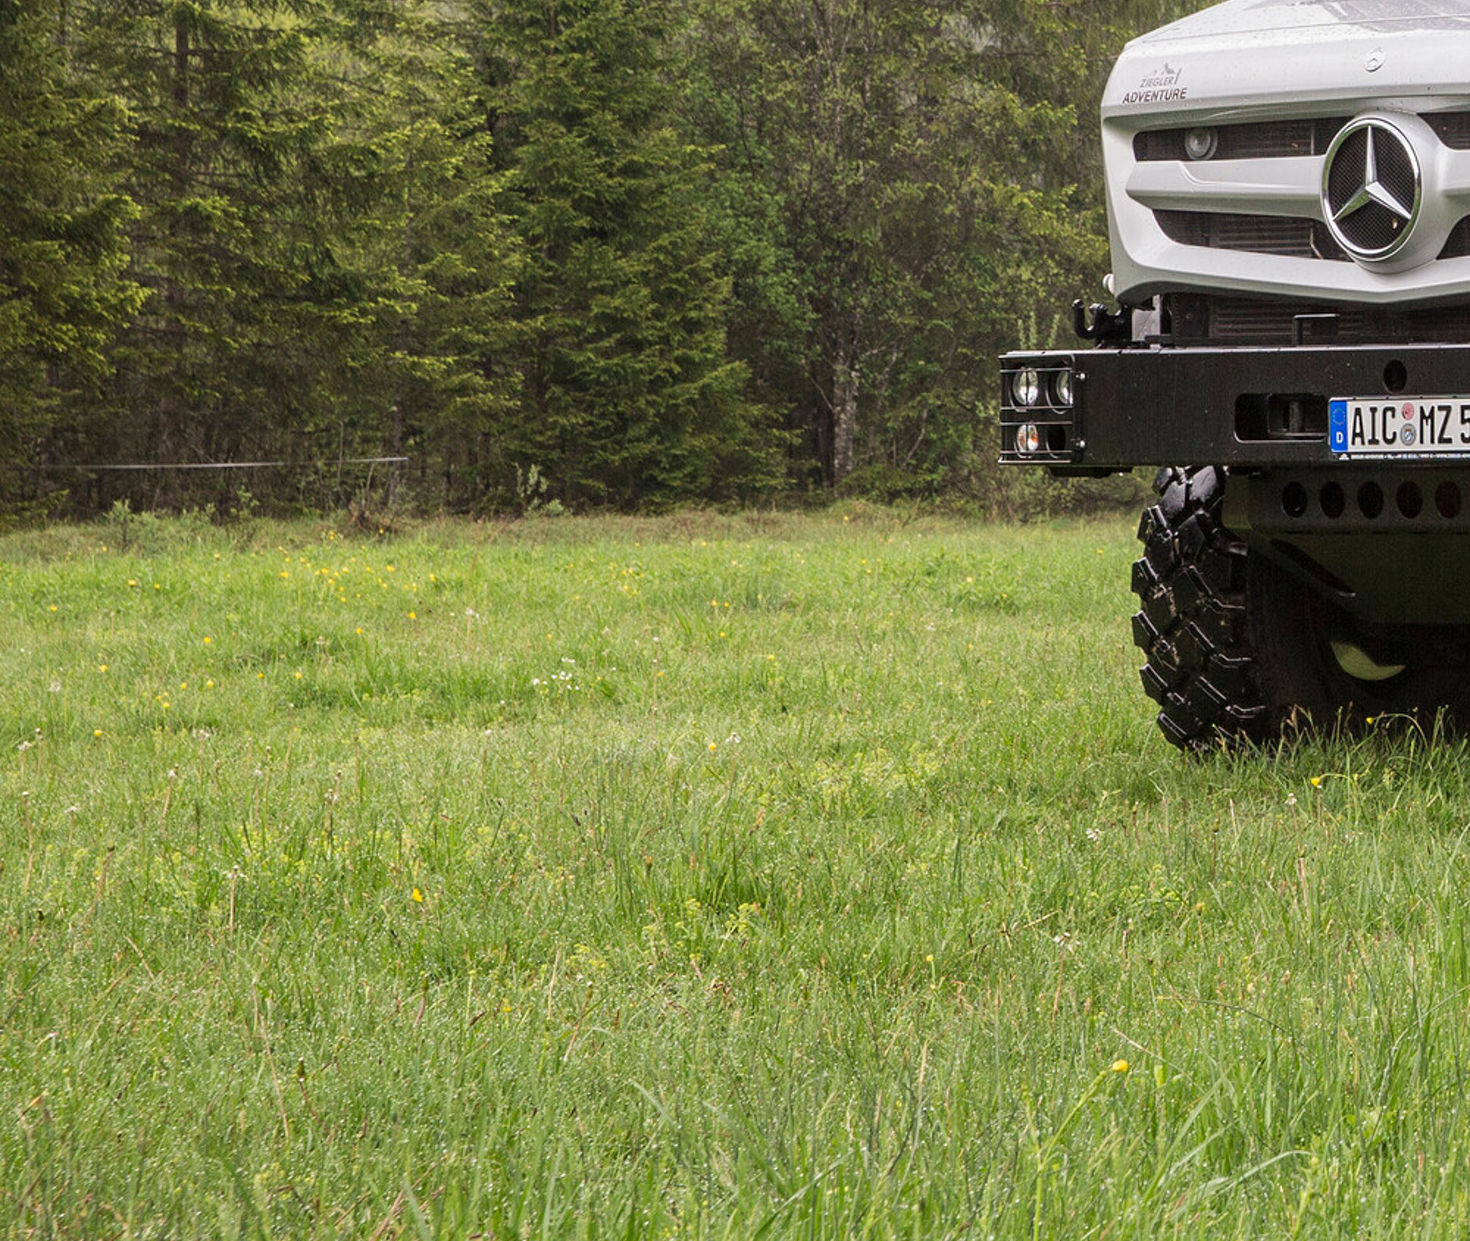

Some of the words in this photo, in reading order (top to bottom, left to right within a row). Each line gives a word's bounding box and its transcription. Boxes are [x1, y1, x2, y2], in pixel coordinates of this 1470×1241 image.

[1122, 87, 1187, 104] ADVENTURE
[1351, 406, 1398, 446] AIC
[1419, 404, 1453, 445] MZ
[1336, 431, 1344, 444] D
